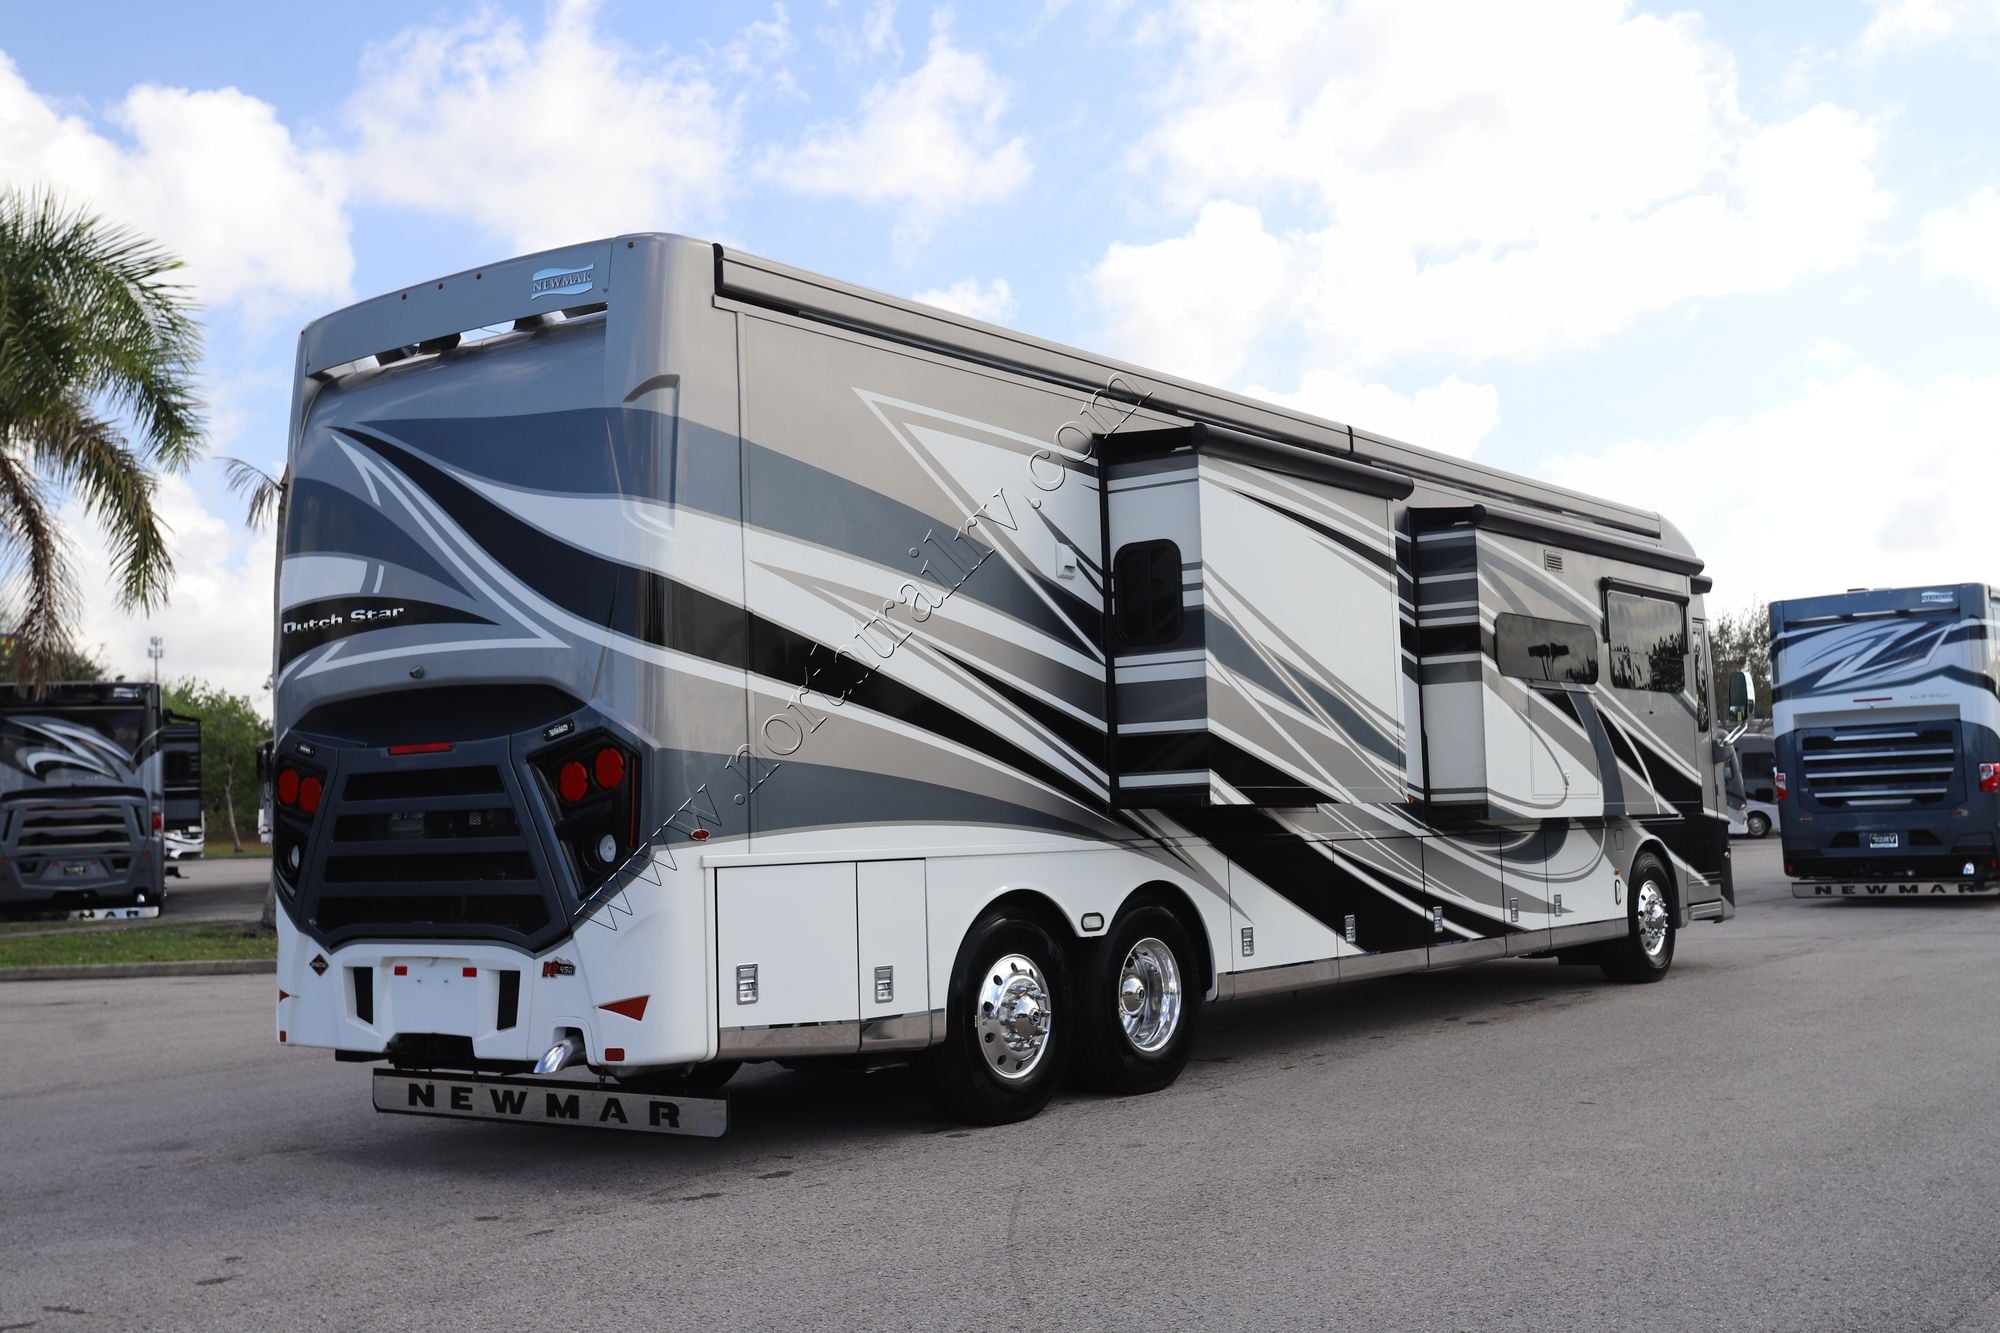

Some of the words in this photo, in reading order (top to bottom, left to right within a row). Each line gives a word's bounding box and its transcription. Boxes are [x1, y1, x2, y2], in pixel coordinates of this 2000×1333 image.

[532, 272, 592, 292] NEWMAR
[283, 613, 343, 633] Dutch
[350, 607, 404, 622] Star
[1815, 884, 1975, 896] NEWMAR
[408, 1083, 681, 1128] NEWMAR
